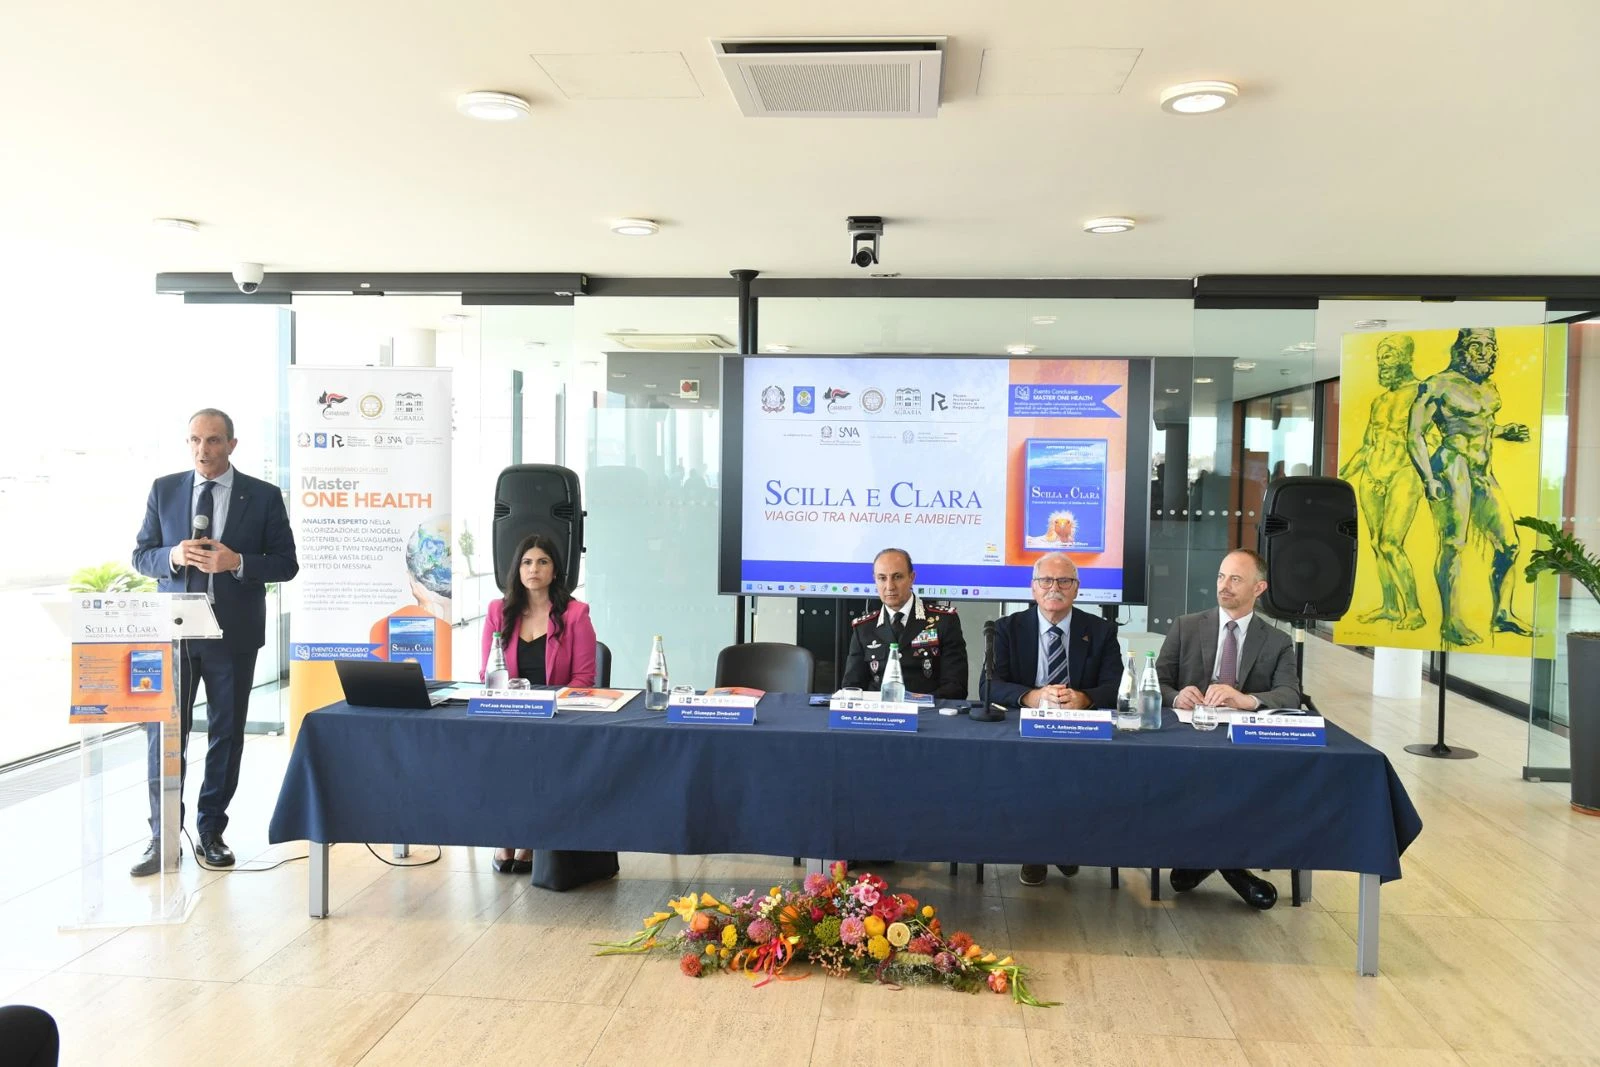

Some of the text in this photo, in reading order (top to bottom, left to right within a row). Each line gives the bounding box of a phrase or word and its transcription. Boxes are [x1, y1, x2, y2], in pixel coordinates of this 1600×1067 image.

[302, 476, 360, 490] Master
[302, 492, 432, 508] ONE HEALTH
[765, 480, 983, 509] SCILLA E CLARA
[1032, 486, 1062, 498] SCILLA
[1070, 486, 1100, 499] CLARA
[764, 510, 983, 525] VIAGGIO TRA NATURA E AMBIENTE
